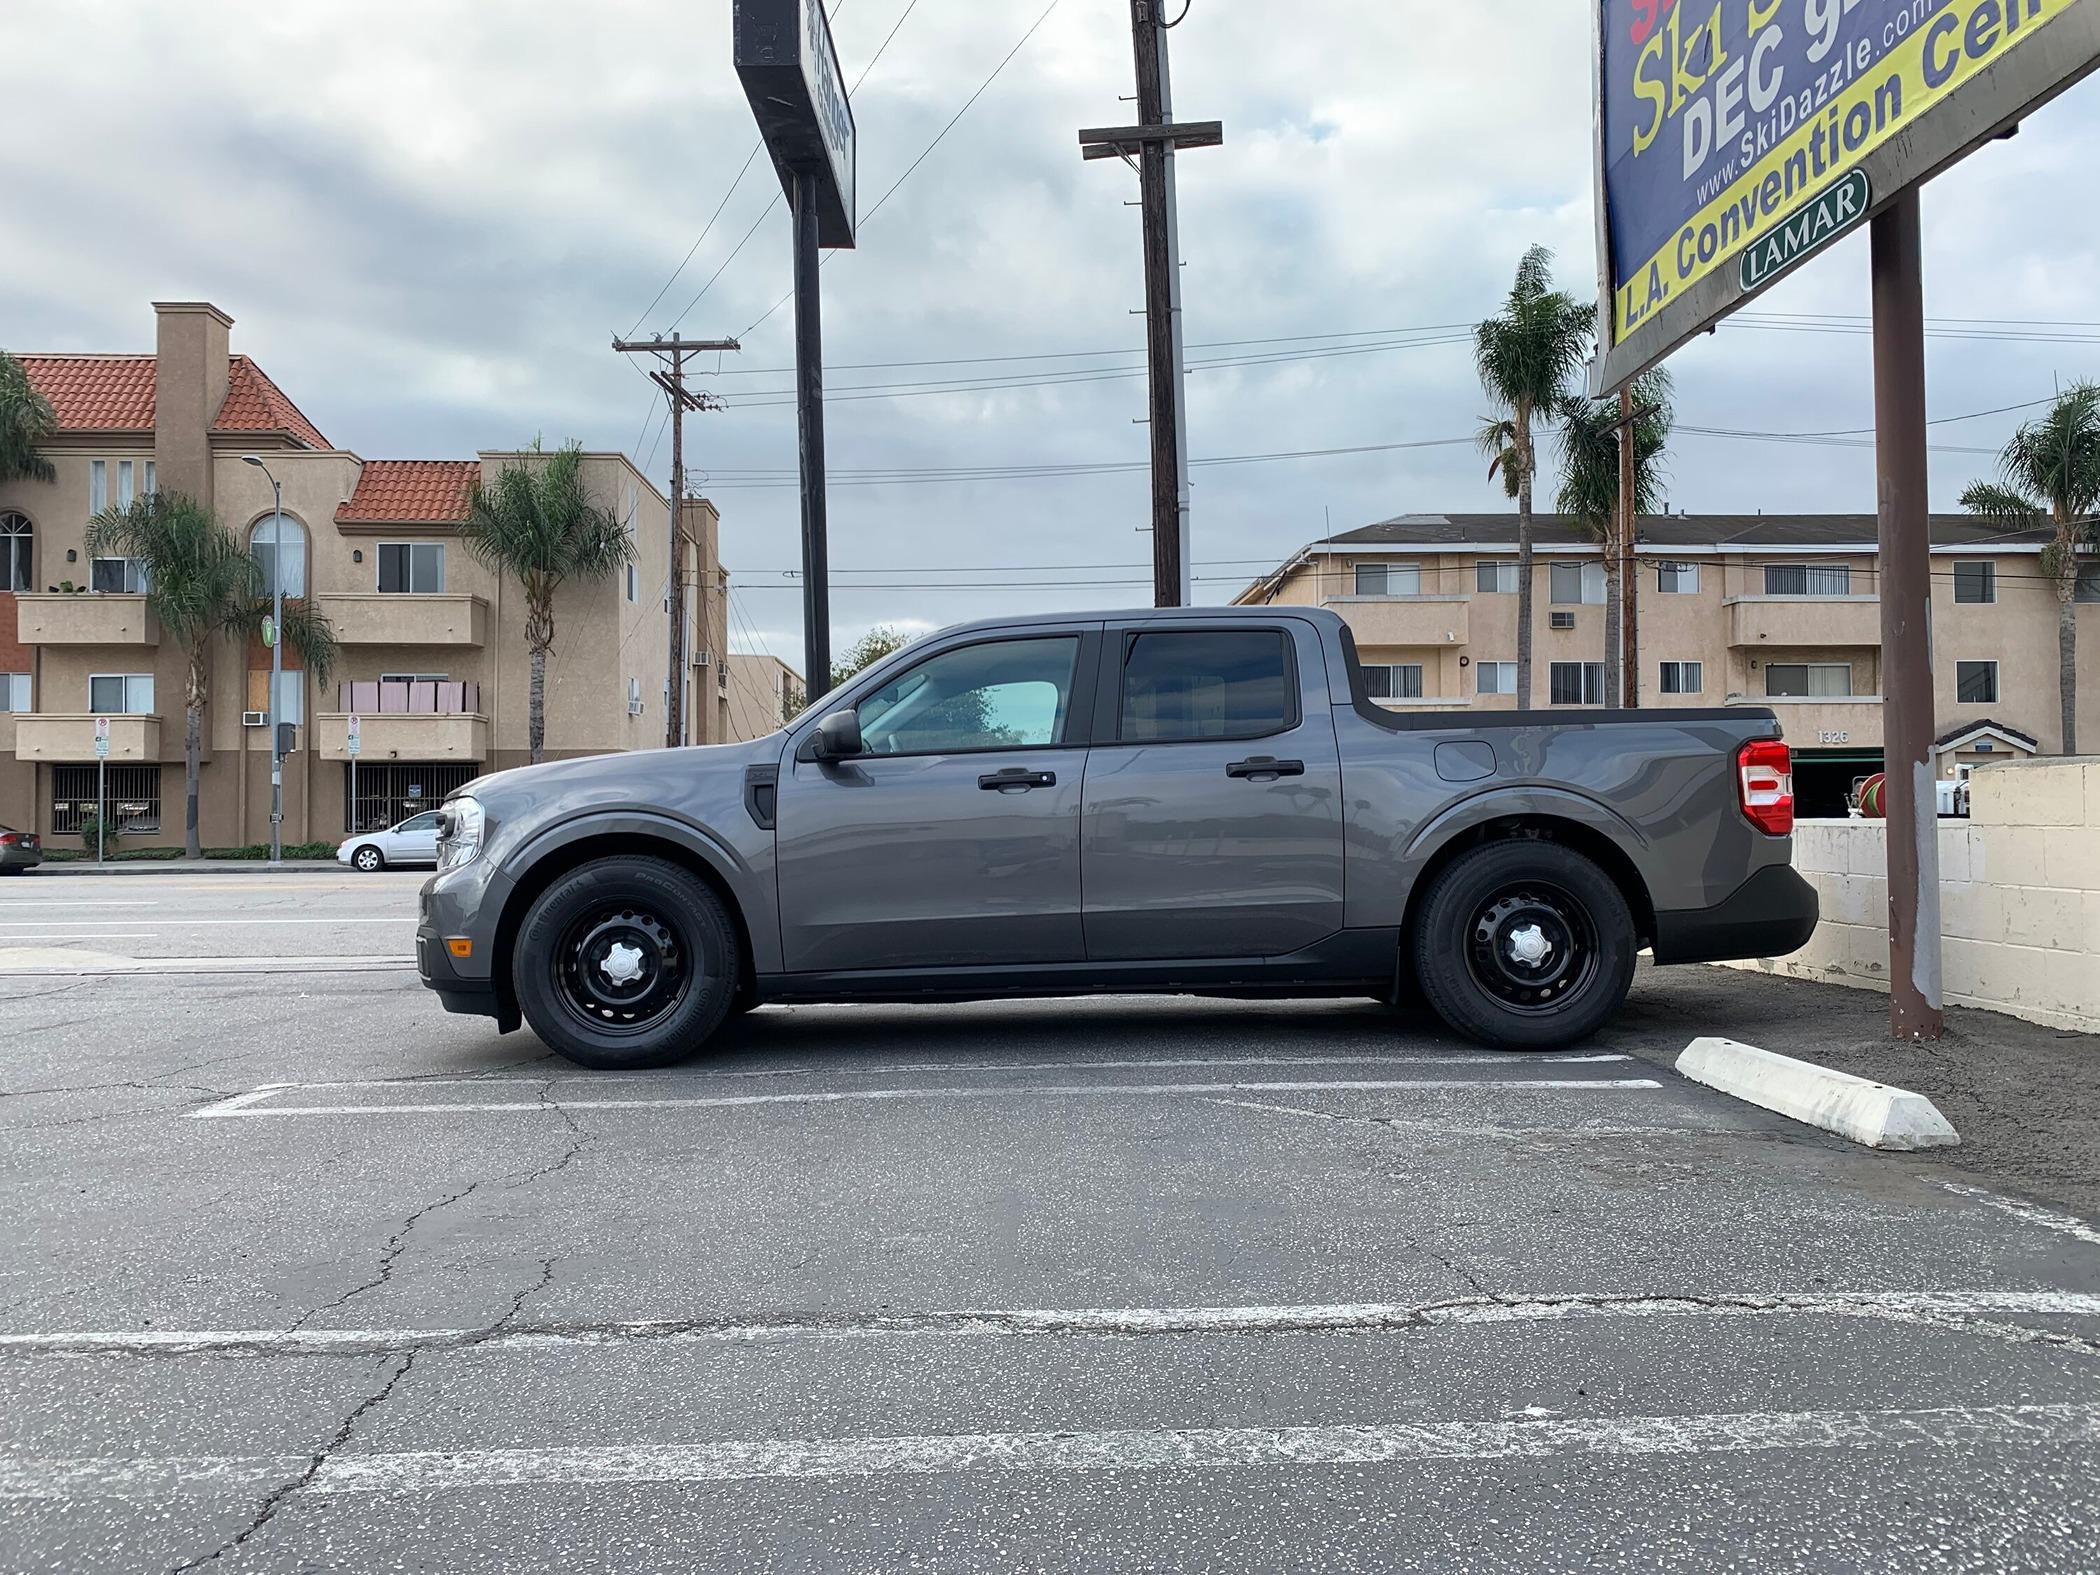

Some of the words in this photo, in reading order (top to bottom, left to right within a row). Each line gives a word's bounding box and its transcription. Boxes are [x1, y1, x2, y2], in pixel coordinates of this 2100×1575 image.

[817, 14, 849, 160] Hanger
[1633, 0, 1728, 158] Ski
[1683, 24, 1784, 181] DEC
[1696, 0, 1932, 206] www.SkiDazzle.com
[1625, 260, 1669, 329] L.A.
[1676, 73, 1903, 280] Convention
[1750, 182, 1857, 282] LAMAR
[1818, 730, 1849, 743] 1326
[528, 883, 576, 942] Continental
